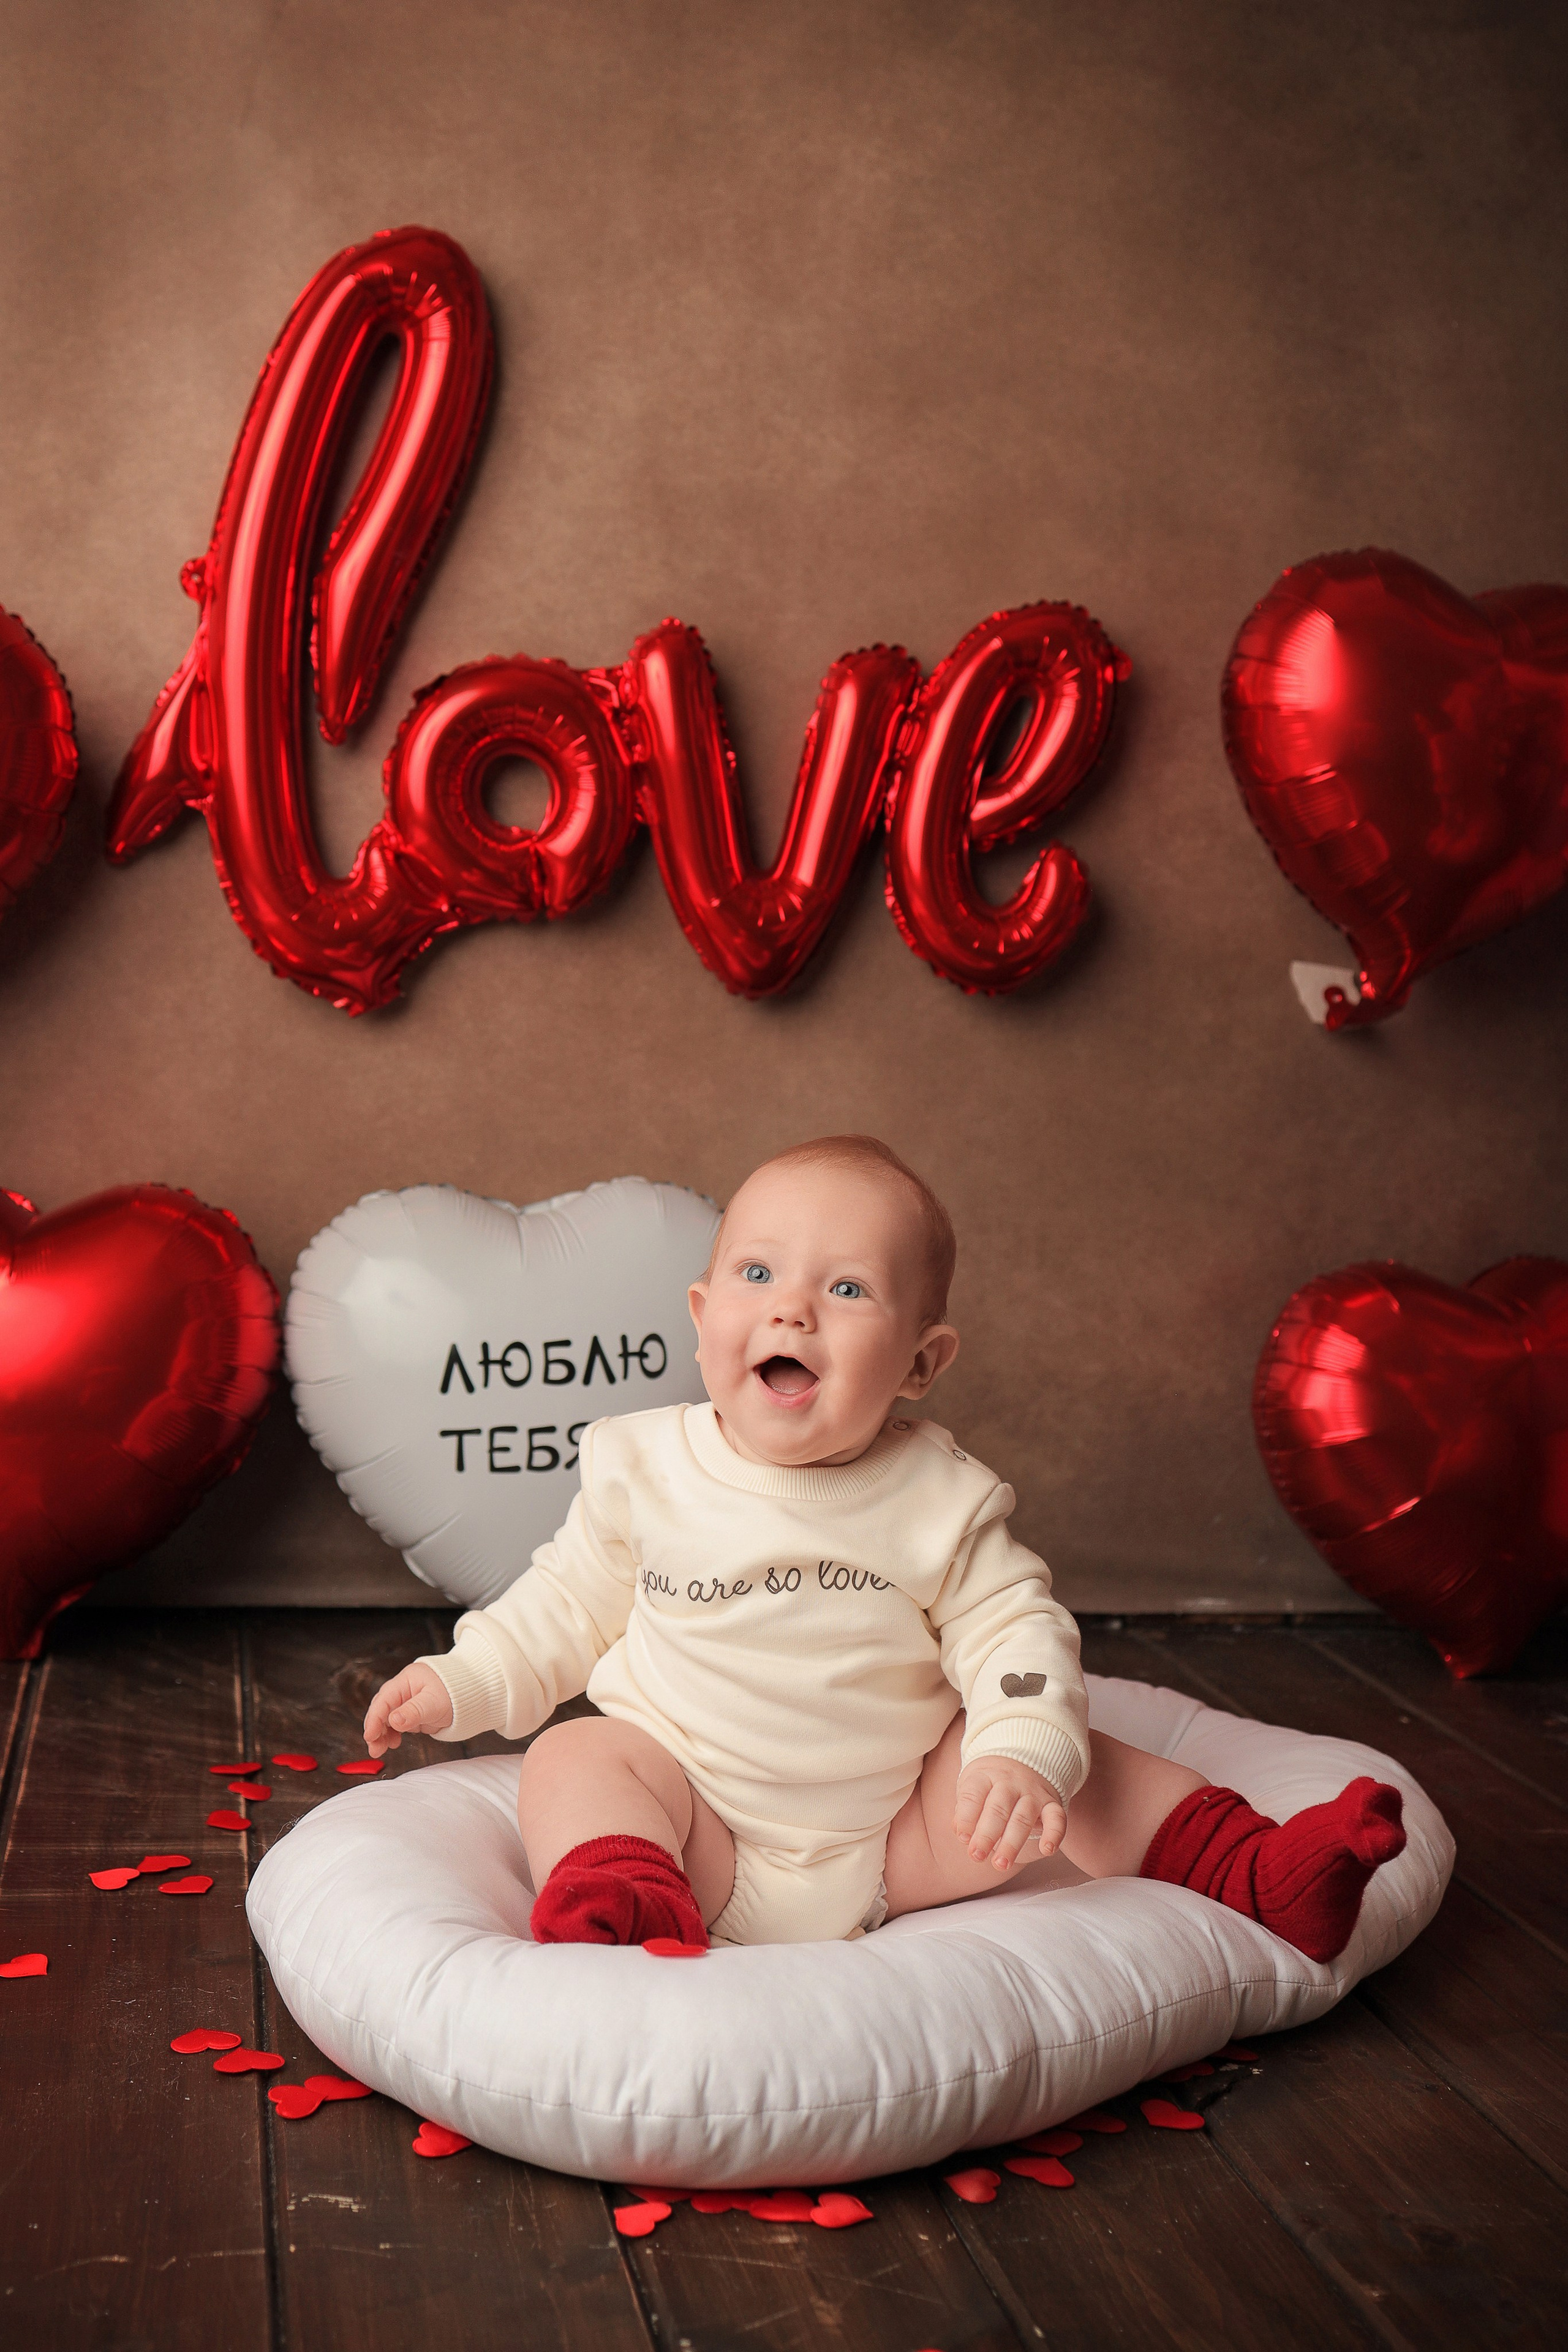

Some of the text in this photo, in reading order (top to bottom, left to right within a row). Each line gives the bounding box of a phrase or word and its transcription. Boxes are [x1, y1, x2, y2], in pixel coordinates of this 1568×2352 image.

[105, 226, 1133, 1017] love
[440, 1333, 668, 1393] ЛЮБЛЮ
[641, 1560, 897, 1603] you are so love
